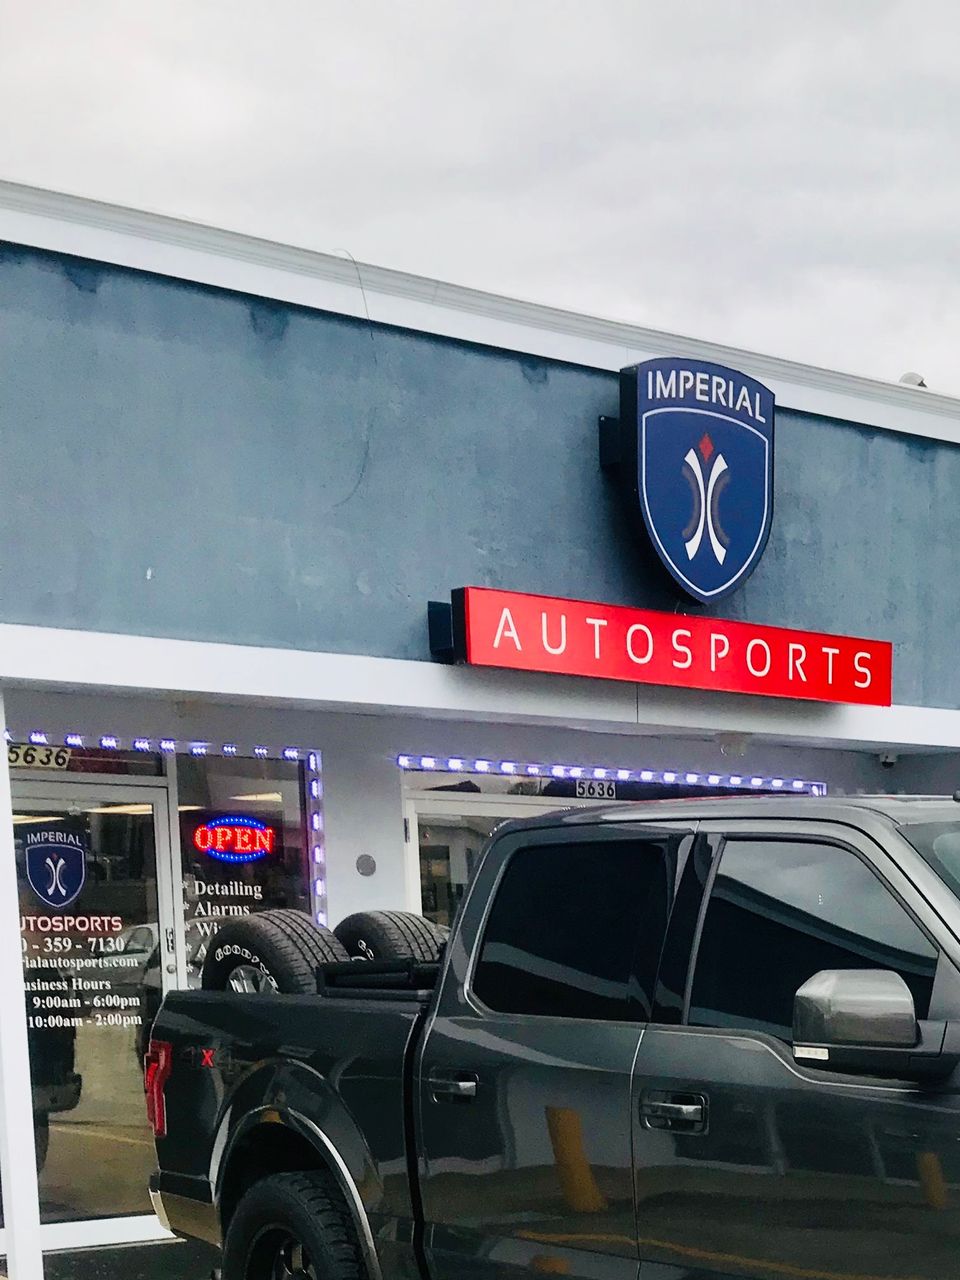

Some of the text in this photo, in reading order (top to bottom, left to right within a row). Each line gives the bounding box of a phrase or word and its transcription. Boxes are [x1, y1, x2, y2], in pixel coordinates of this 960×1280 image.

[647, 370, 766, 424] IMPERIAL
[493, 608, 872, 689] AUTOSPORTS
[8, 746, 68, 767] 5636
[577, 781, 615, 797] 5636
[27, 831, 82, 846] IMPERIAL
[195, 826, 273, 854] OPEN
[194, 880, 263, 900] Detailing
[195, 901, 250, 917] Alarms
[20, 916, 123, 932] UTOSPORTS
[43, 937, 72, 953] 359
[87, 936, 125, 953] 7130
[24, 978, 112, 991] usiness Hours
[32, 996, 82, 1009] 9:00am
[92, 995, 141, 1010] 6:00pm
[28, 1015, 84, 1028] 10:00am
[95, 1013, 143, 1028] 2:00pm
